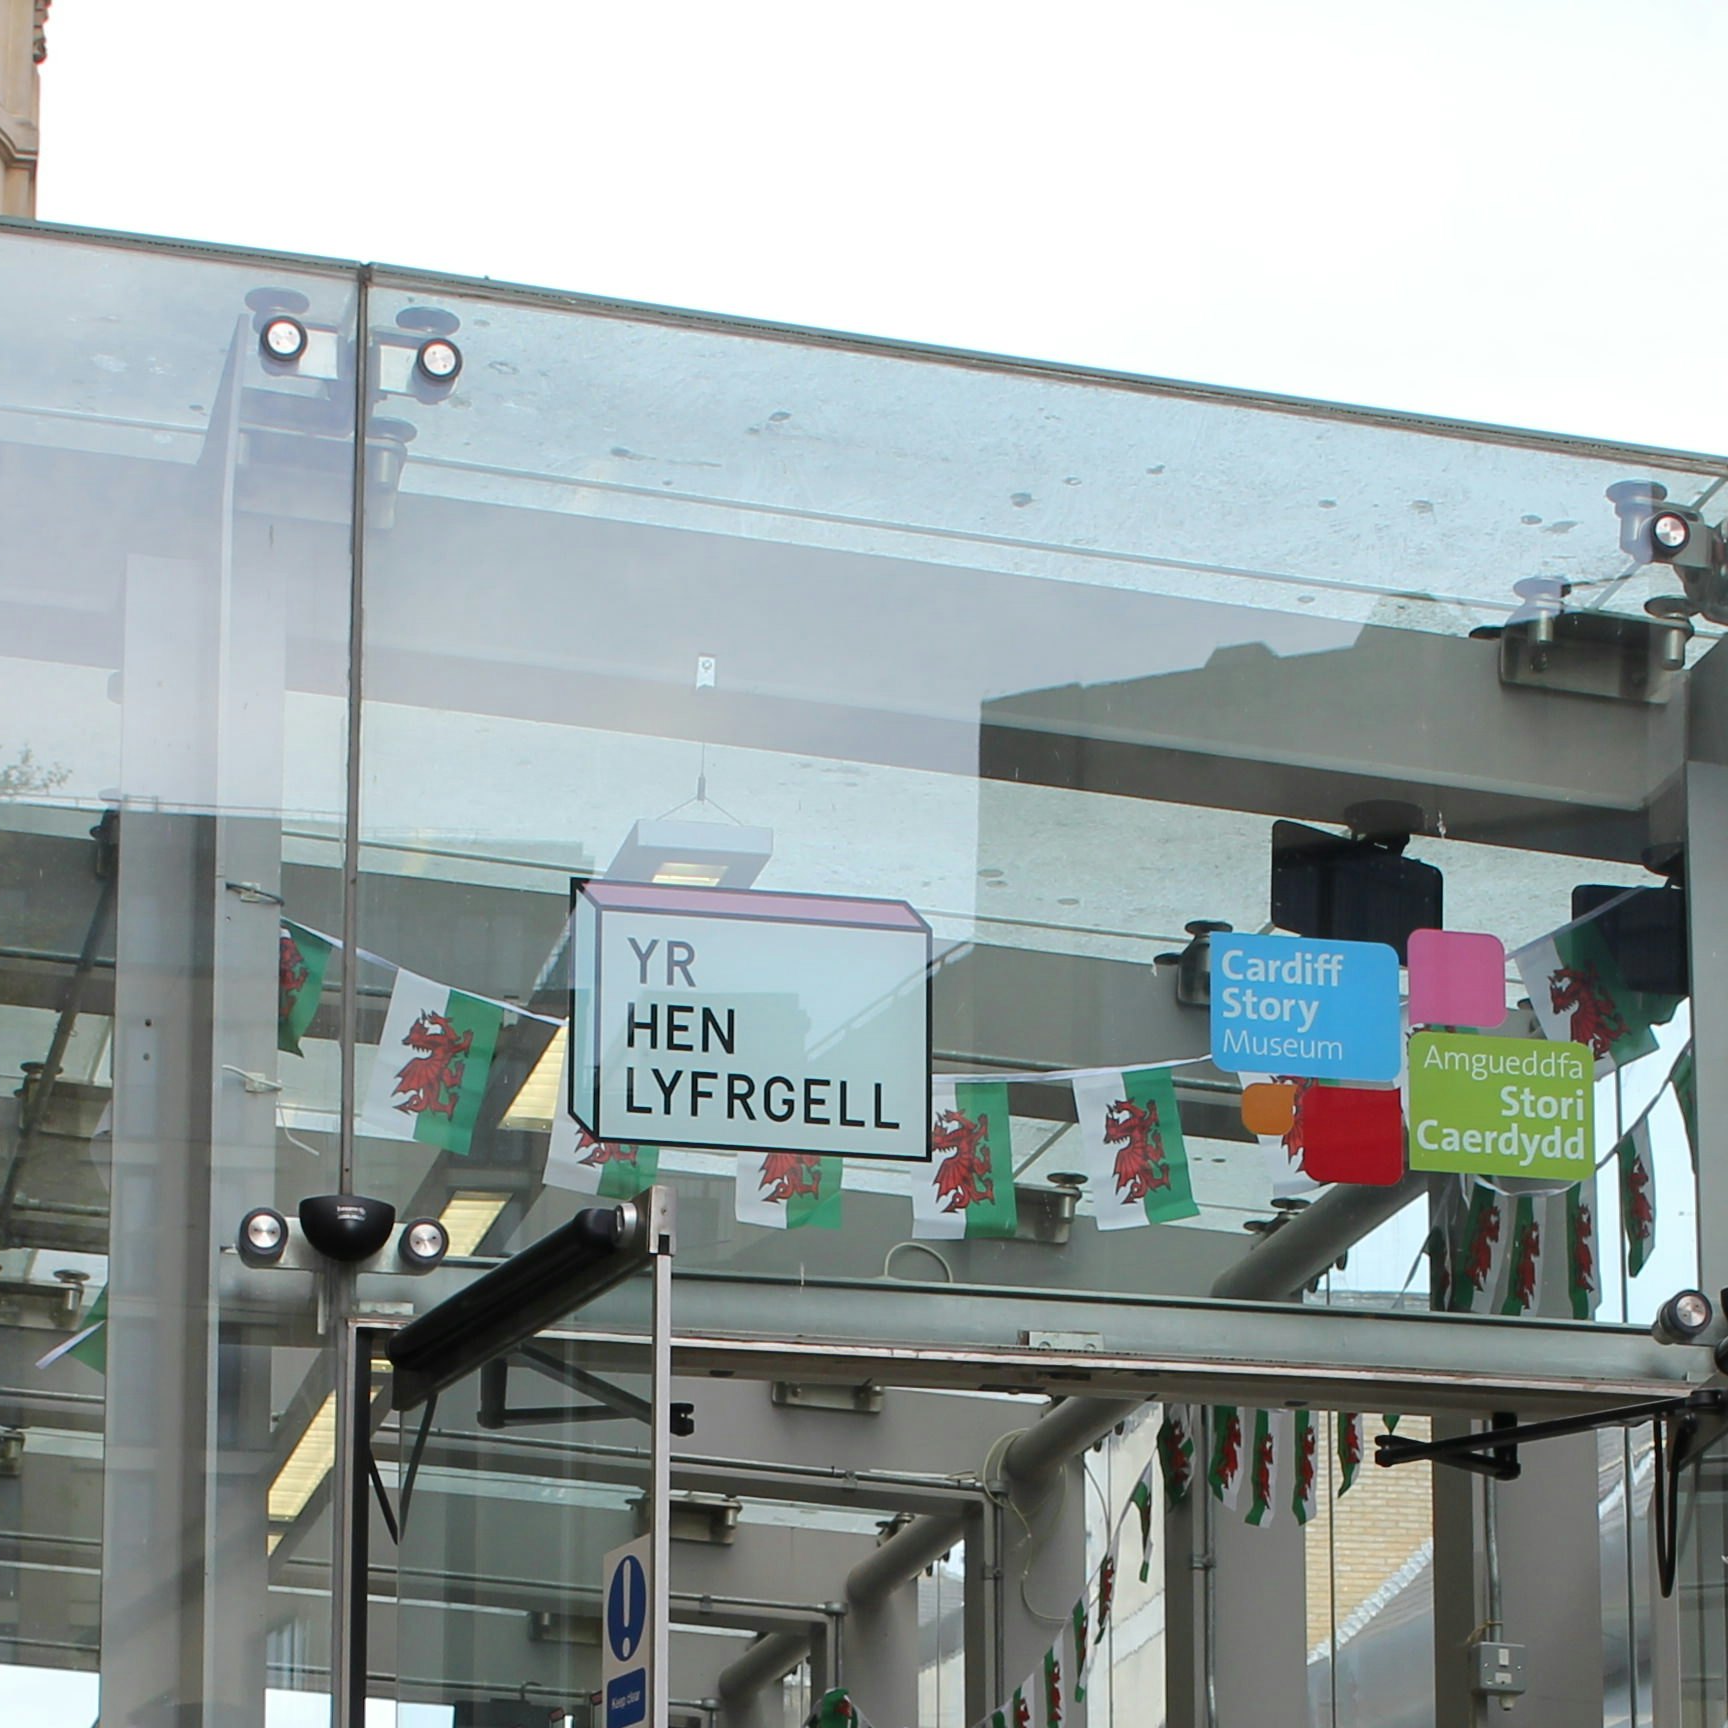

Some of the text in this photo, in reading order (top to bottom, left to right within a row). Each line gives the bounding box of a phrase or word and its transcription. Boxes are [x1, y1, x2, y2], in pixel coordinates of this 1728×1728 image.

[626, 936, 696, 989] YR
[1220, 946, 1344, 987] Cardiff
[625, 1001, 737, 1056] HEN
[1222, 987, 1320, 1033] Story
[1222, 1028, 1344, 1062] Museum
[1421, 1043, 1585, 1083] Amgueddfa
[624, 1063, 902, 1132] LYFRGELL
[1497, 1083, 1585, 1121] Stori
[1414, 1119, 1587, 1164] Caerdydd
